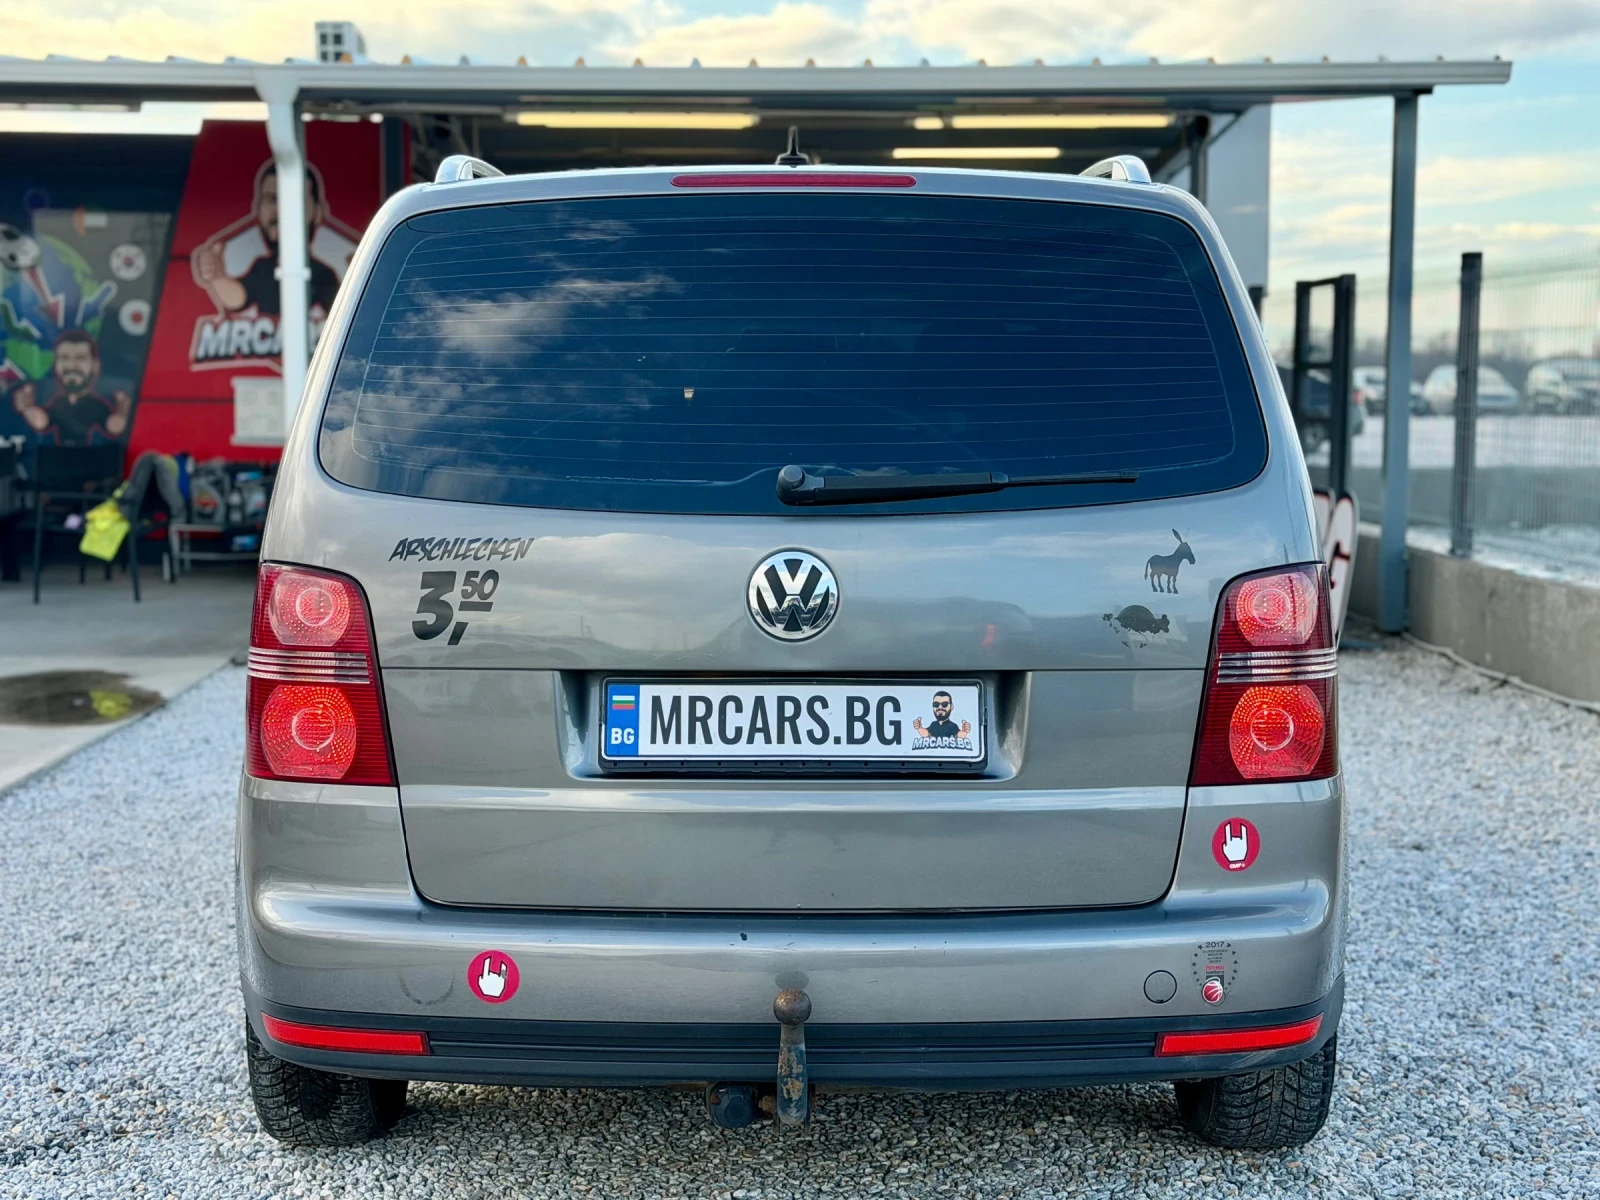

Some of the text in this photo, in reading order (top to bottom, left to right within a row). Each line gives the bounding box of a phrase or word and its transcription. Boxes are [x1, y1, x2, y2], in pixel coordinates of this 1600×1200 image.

[388, 537, 535, 562] ARSCHLECKEN
[649, 695, 902, 746] MRCARS.BG
[611, 727, 635, 745] BG
[911, 735, 973, 751] MRCARS.BG
